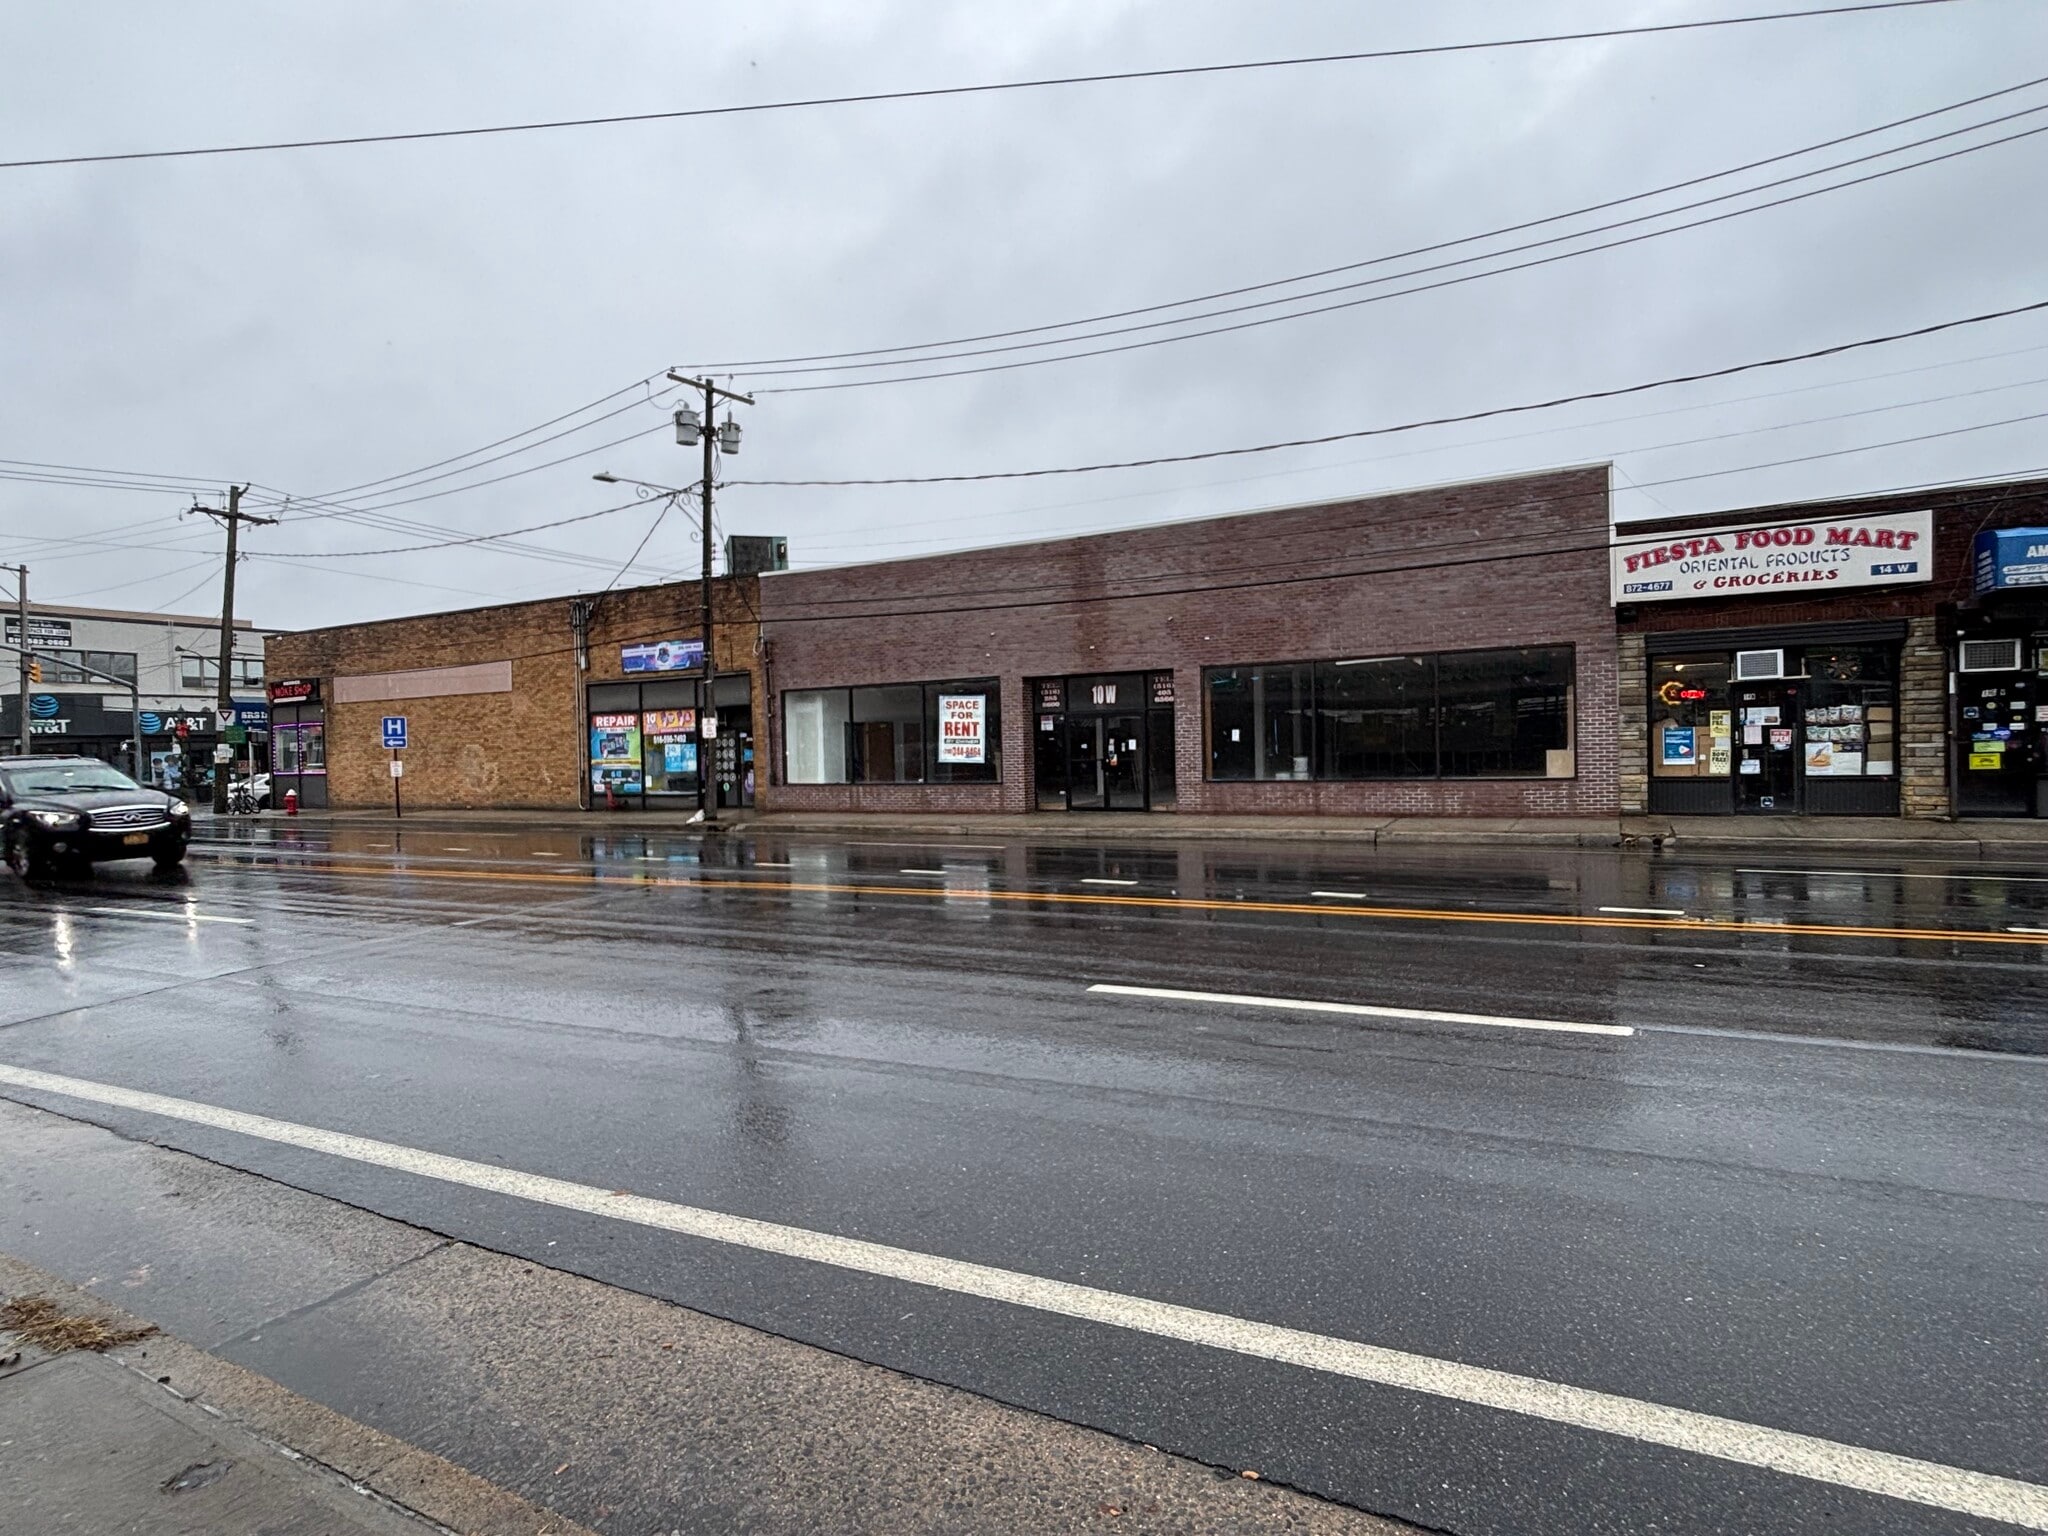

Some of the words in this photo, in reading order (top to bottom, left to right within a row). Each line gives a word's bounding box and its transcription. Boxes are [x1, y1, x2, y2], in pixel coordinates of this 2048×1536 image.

[1624, 536, 1725, 573] FIESTA
[1735, 527, 1815, 550] FOOD
[1825, 527, 1919, 551] MART
[1680, 556, 1759, 574] ORIENTAL
[1766, 548, 1850, 568] PRODUCTS
[1879, 565, 1892, 574] 14
[1898, 564, 1910, 573] W
[1713, 568, 1840, 588] GROCERIES
[1626, 581, 1671, 593] 872-4677
[294, 683, 312, 696] SHOP
[1092, 686, 1104, 704] 10
[1105, 685, 1117, 704] W
[945, 700, 979, 710] SPACE
[387, 719, 402, 735] H
[596, 715, 635, 727] REPAIR
[944, 722, 980, 737] RENT
